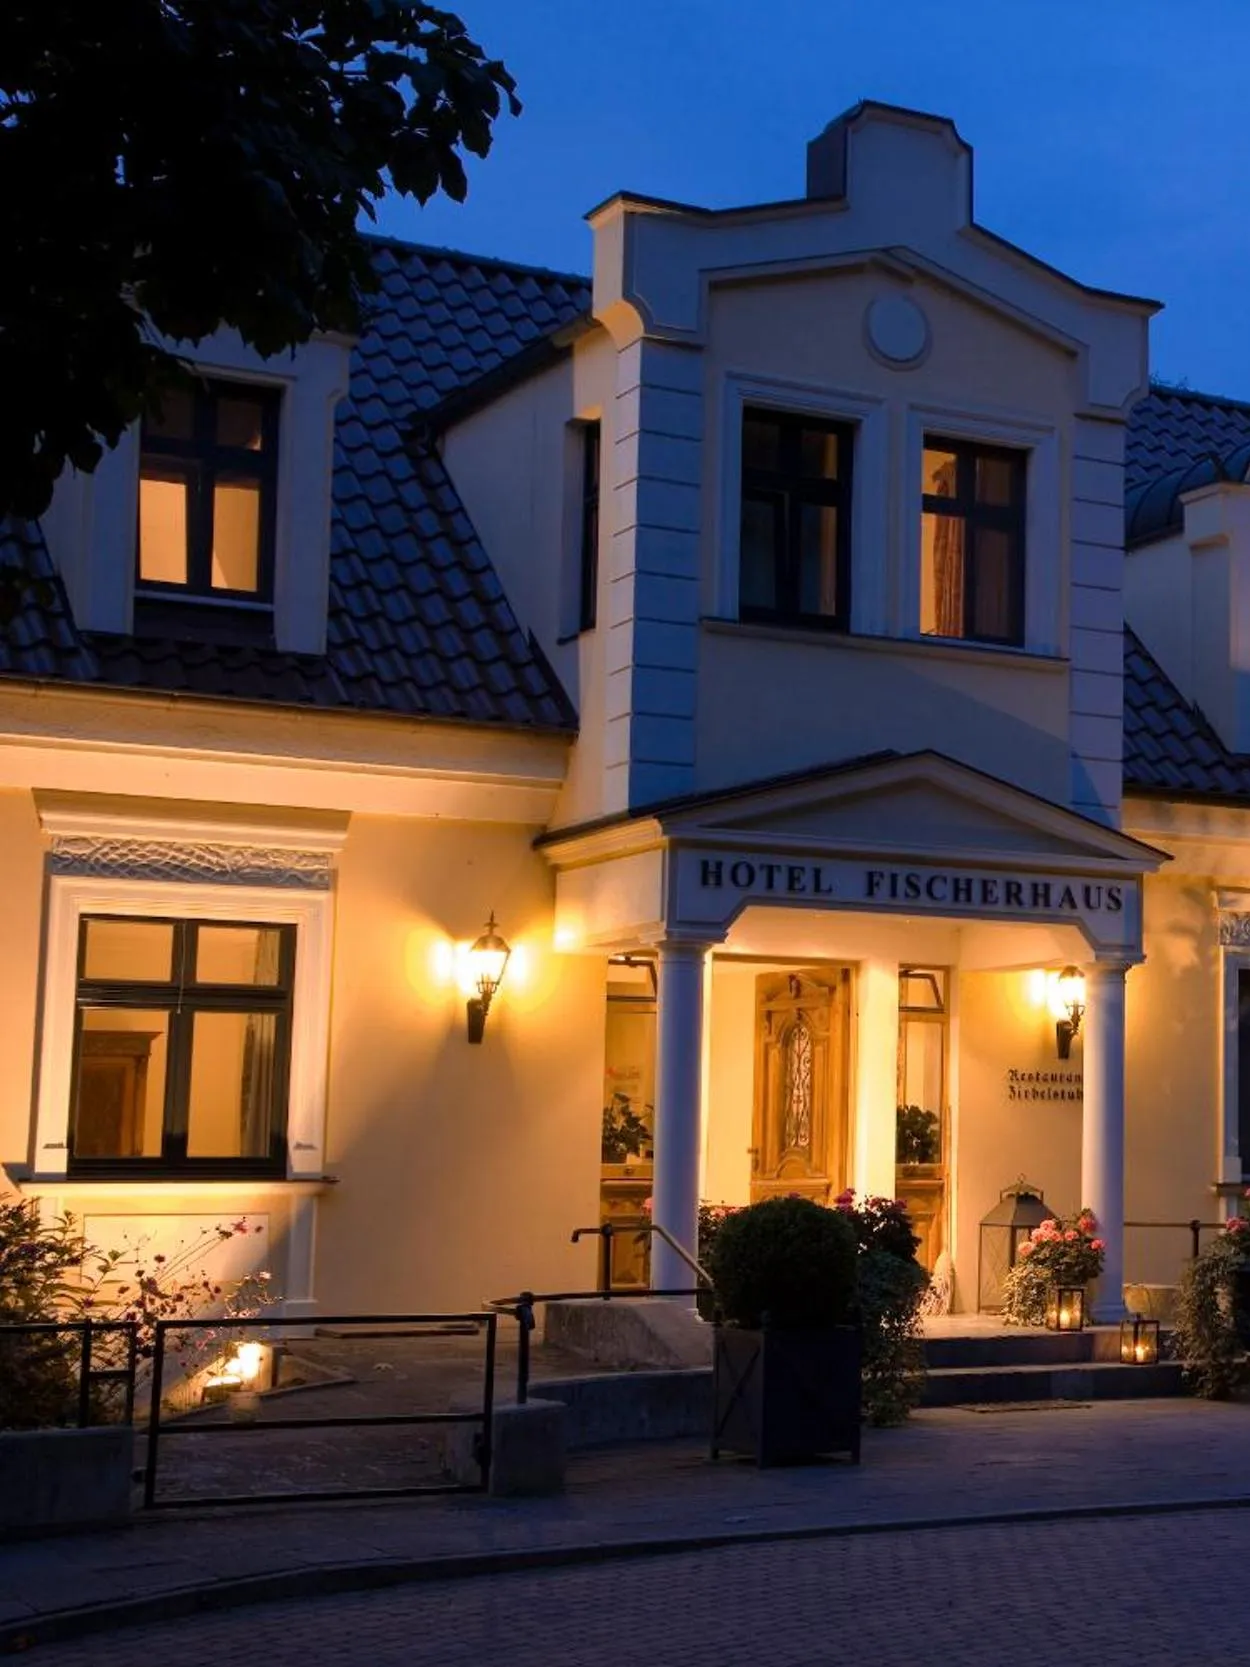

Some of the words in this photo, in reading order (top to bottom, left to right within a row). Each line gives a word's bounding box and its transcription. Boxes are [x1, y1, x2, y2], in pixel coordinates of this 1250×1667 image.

[701, 859, 833, 893] HOTEL
[865, 870, 1123, 911] FISCHERHAUS
[1008, 1068, 1082, 1082] Restauran
[1008, 1085, 1083, 1100] Zirbelstub
